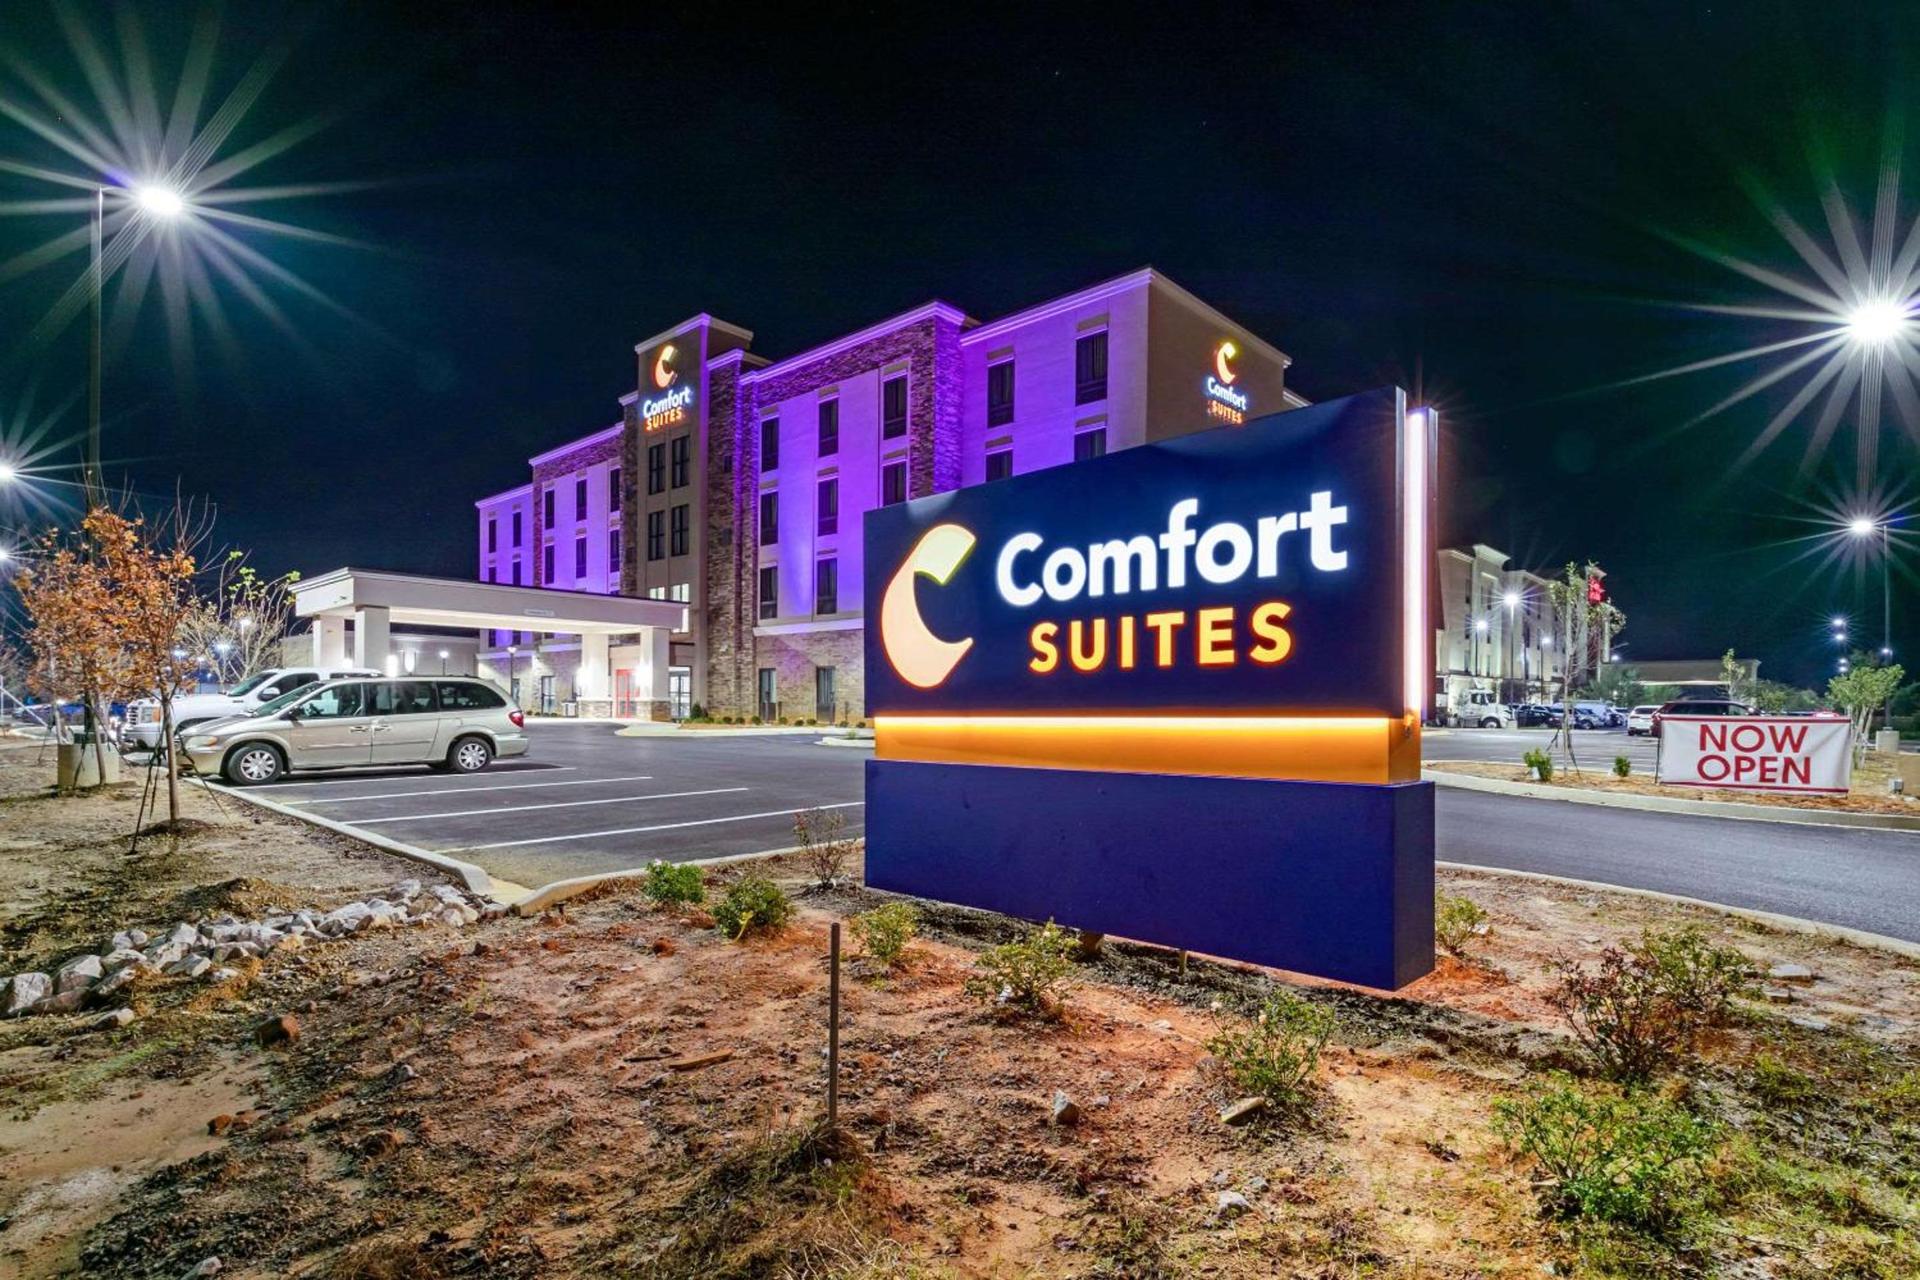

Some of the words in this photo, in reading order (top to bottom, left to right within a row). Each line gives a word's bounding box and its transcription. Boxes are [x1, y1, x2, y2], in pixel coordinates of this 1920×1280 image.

[643, 386, 691, 418] Comfort
[1207, 376, 1247, 411] Comfort
[646, 406, 684, 431] SUITES
[1211, 400, 1242, 424] SUITES
[997, 491, 1348, 606] Comfort
[1028, 602, 1292, 674] SUITES
[1700, 724, 1808, 753] NOW
[1696, 754, 1811, 784] OPEN
